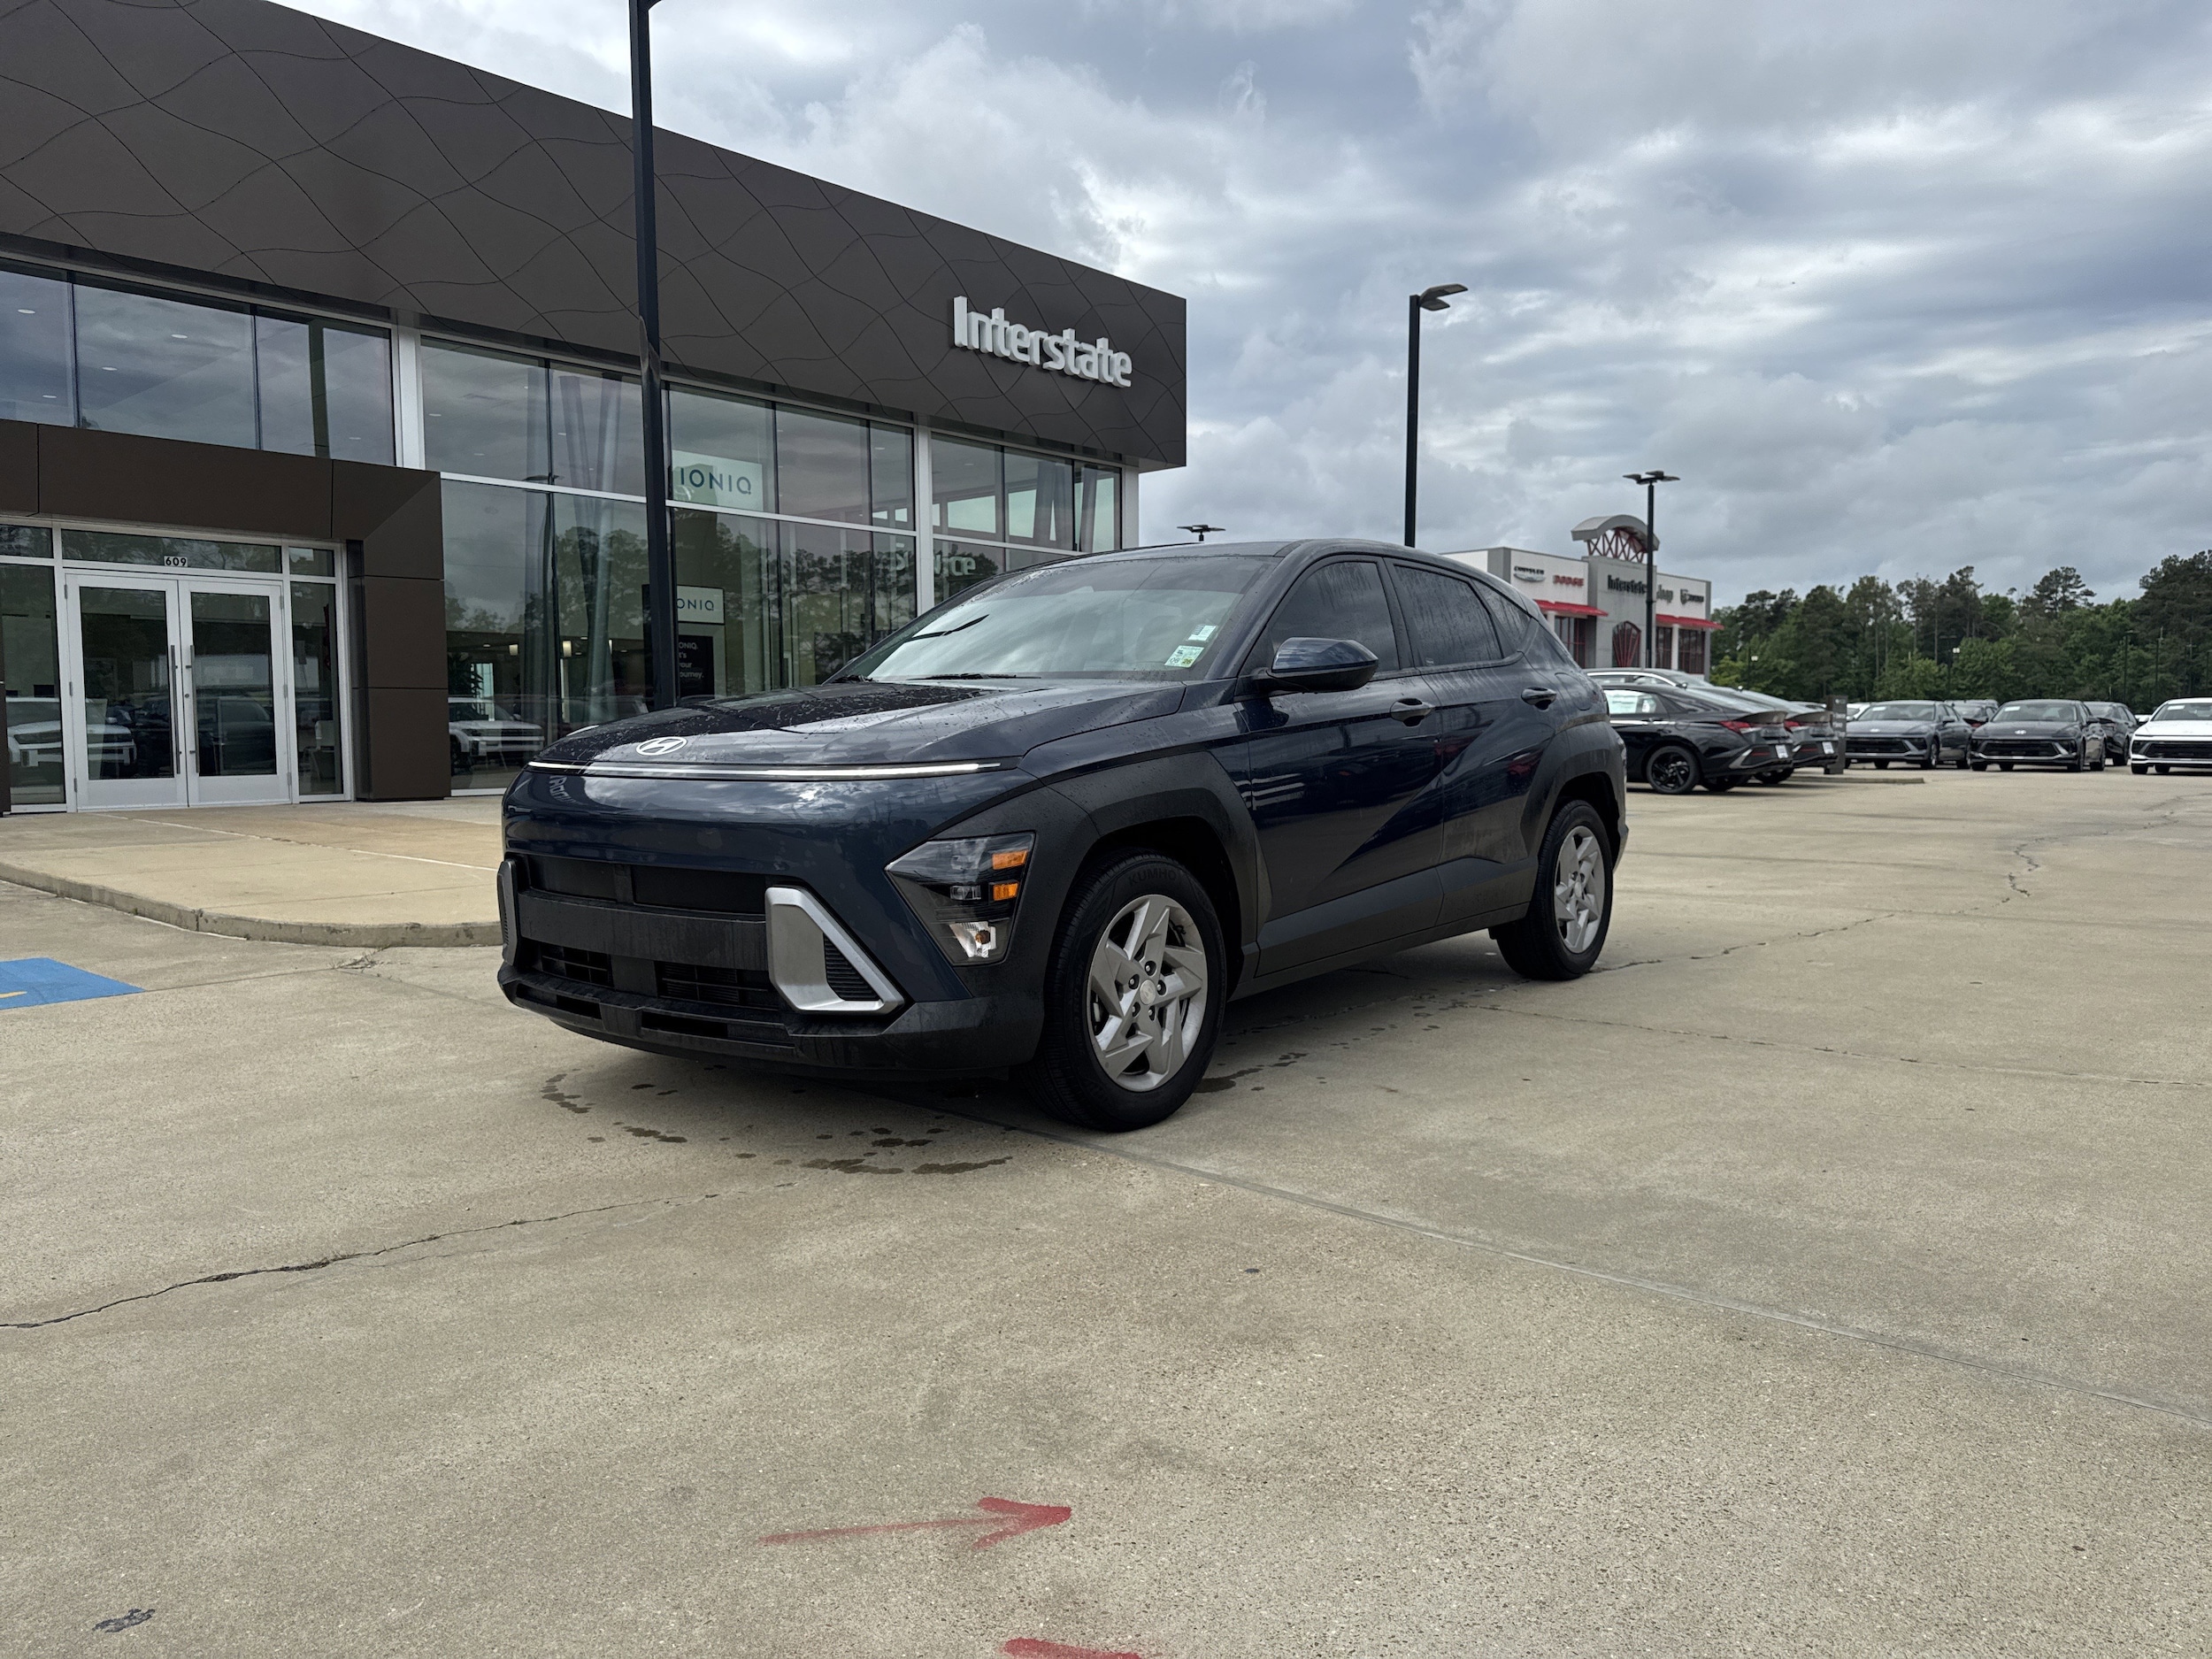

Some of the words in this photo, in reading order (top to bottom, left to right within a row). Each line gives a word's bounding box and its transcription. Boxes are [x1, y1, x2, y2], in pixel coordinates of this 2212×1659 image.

[953, 296, 1133, 388] Interstate
[680, 467, 751, 495] IONIQ
[165, 557, 187, 566] 609
[677, 598, 714, 611] ONIQ
[680, 671, 704, 680] ourney.
[1128, 867, 1177, 887] KUMHO
